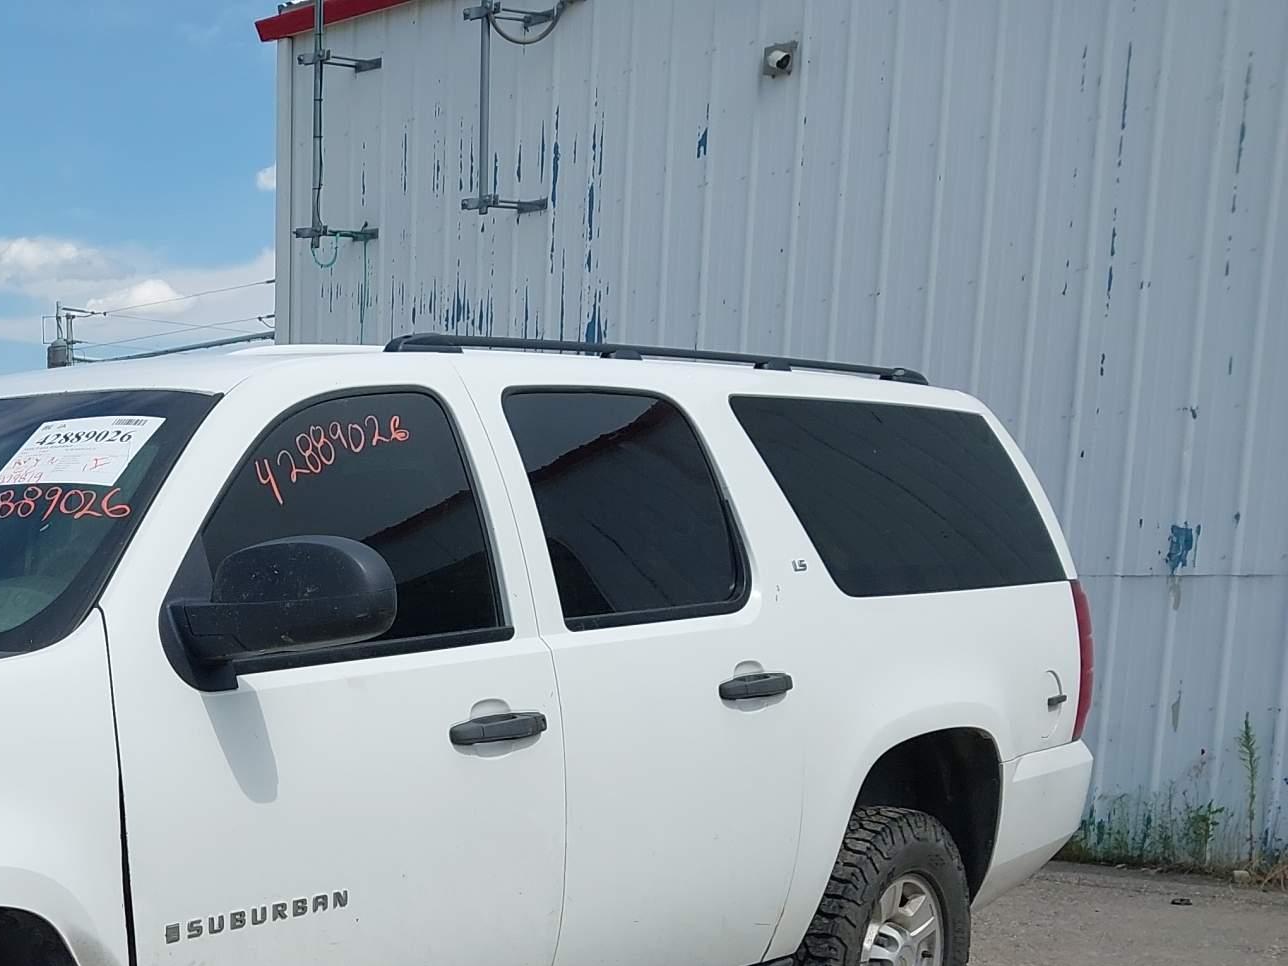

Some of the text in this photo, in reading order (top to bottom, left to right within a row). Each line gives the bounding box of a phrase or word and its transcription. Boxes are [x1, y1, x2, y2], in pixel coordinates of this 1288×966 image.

[36, 430, 137, 446] 42889026
[254, 415, 410, 505] 42889026
[187, 889, 349, 939] SUBURBAN
